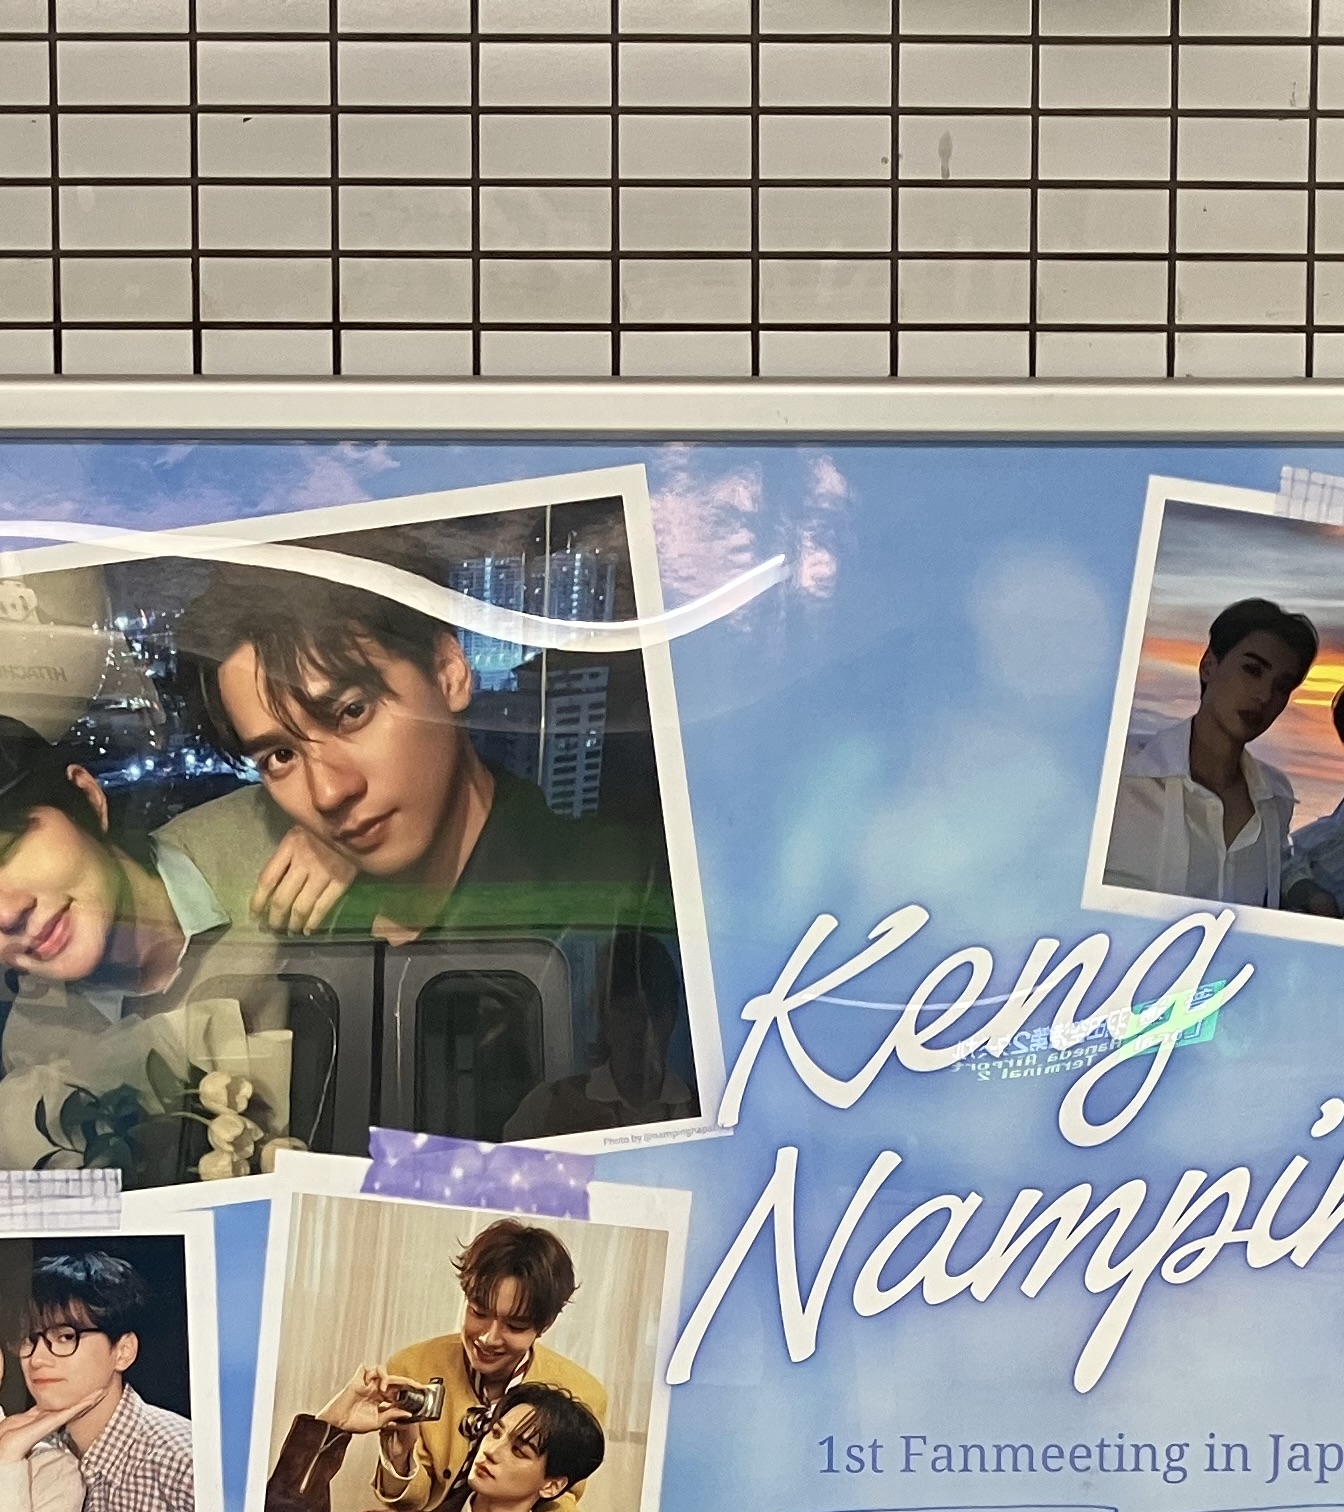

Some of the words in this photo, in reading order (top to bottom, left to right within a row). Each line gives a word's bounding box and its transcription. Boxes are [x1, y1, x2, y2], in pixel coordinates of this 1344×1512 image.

[718, 903, 1255, 1148] Keng
[818, 1435, 884, 1474] 1st
[900, 1433, 1190, 1484] Fanmeeting
[1204, 1433, 1252, 1474] in
